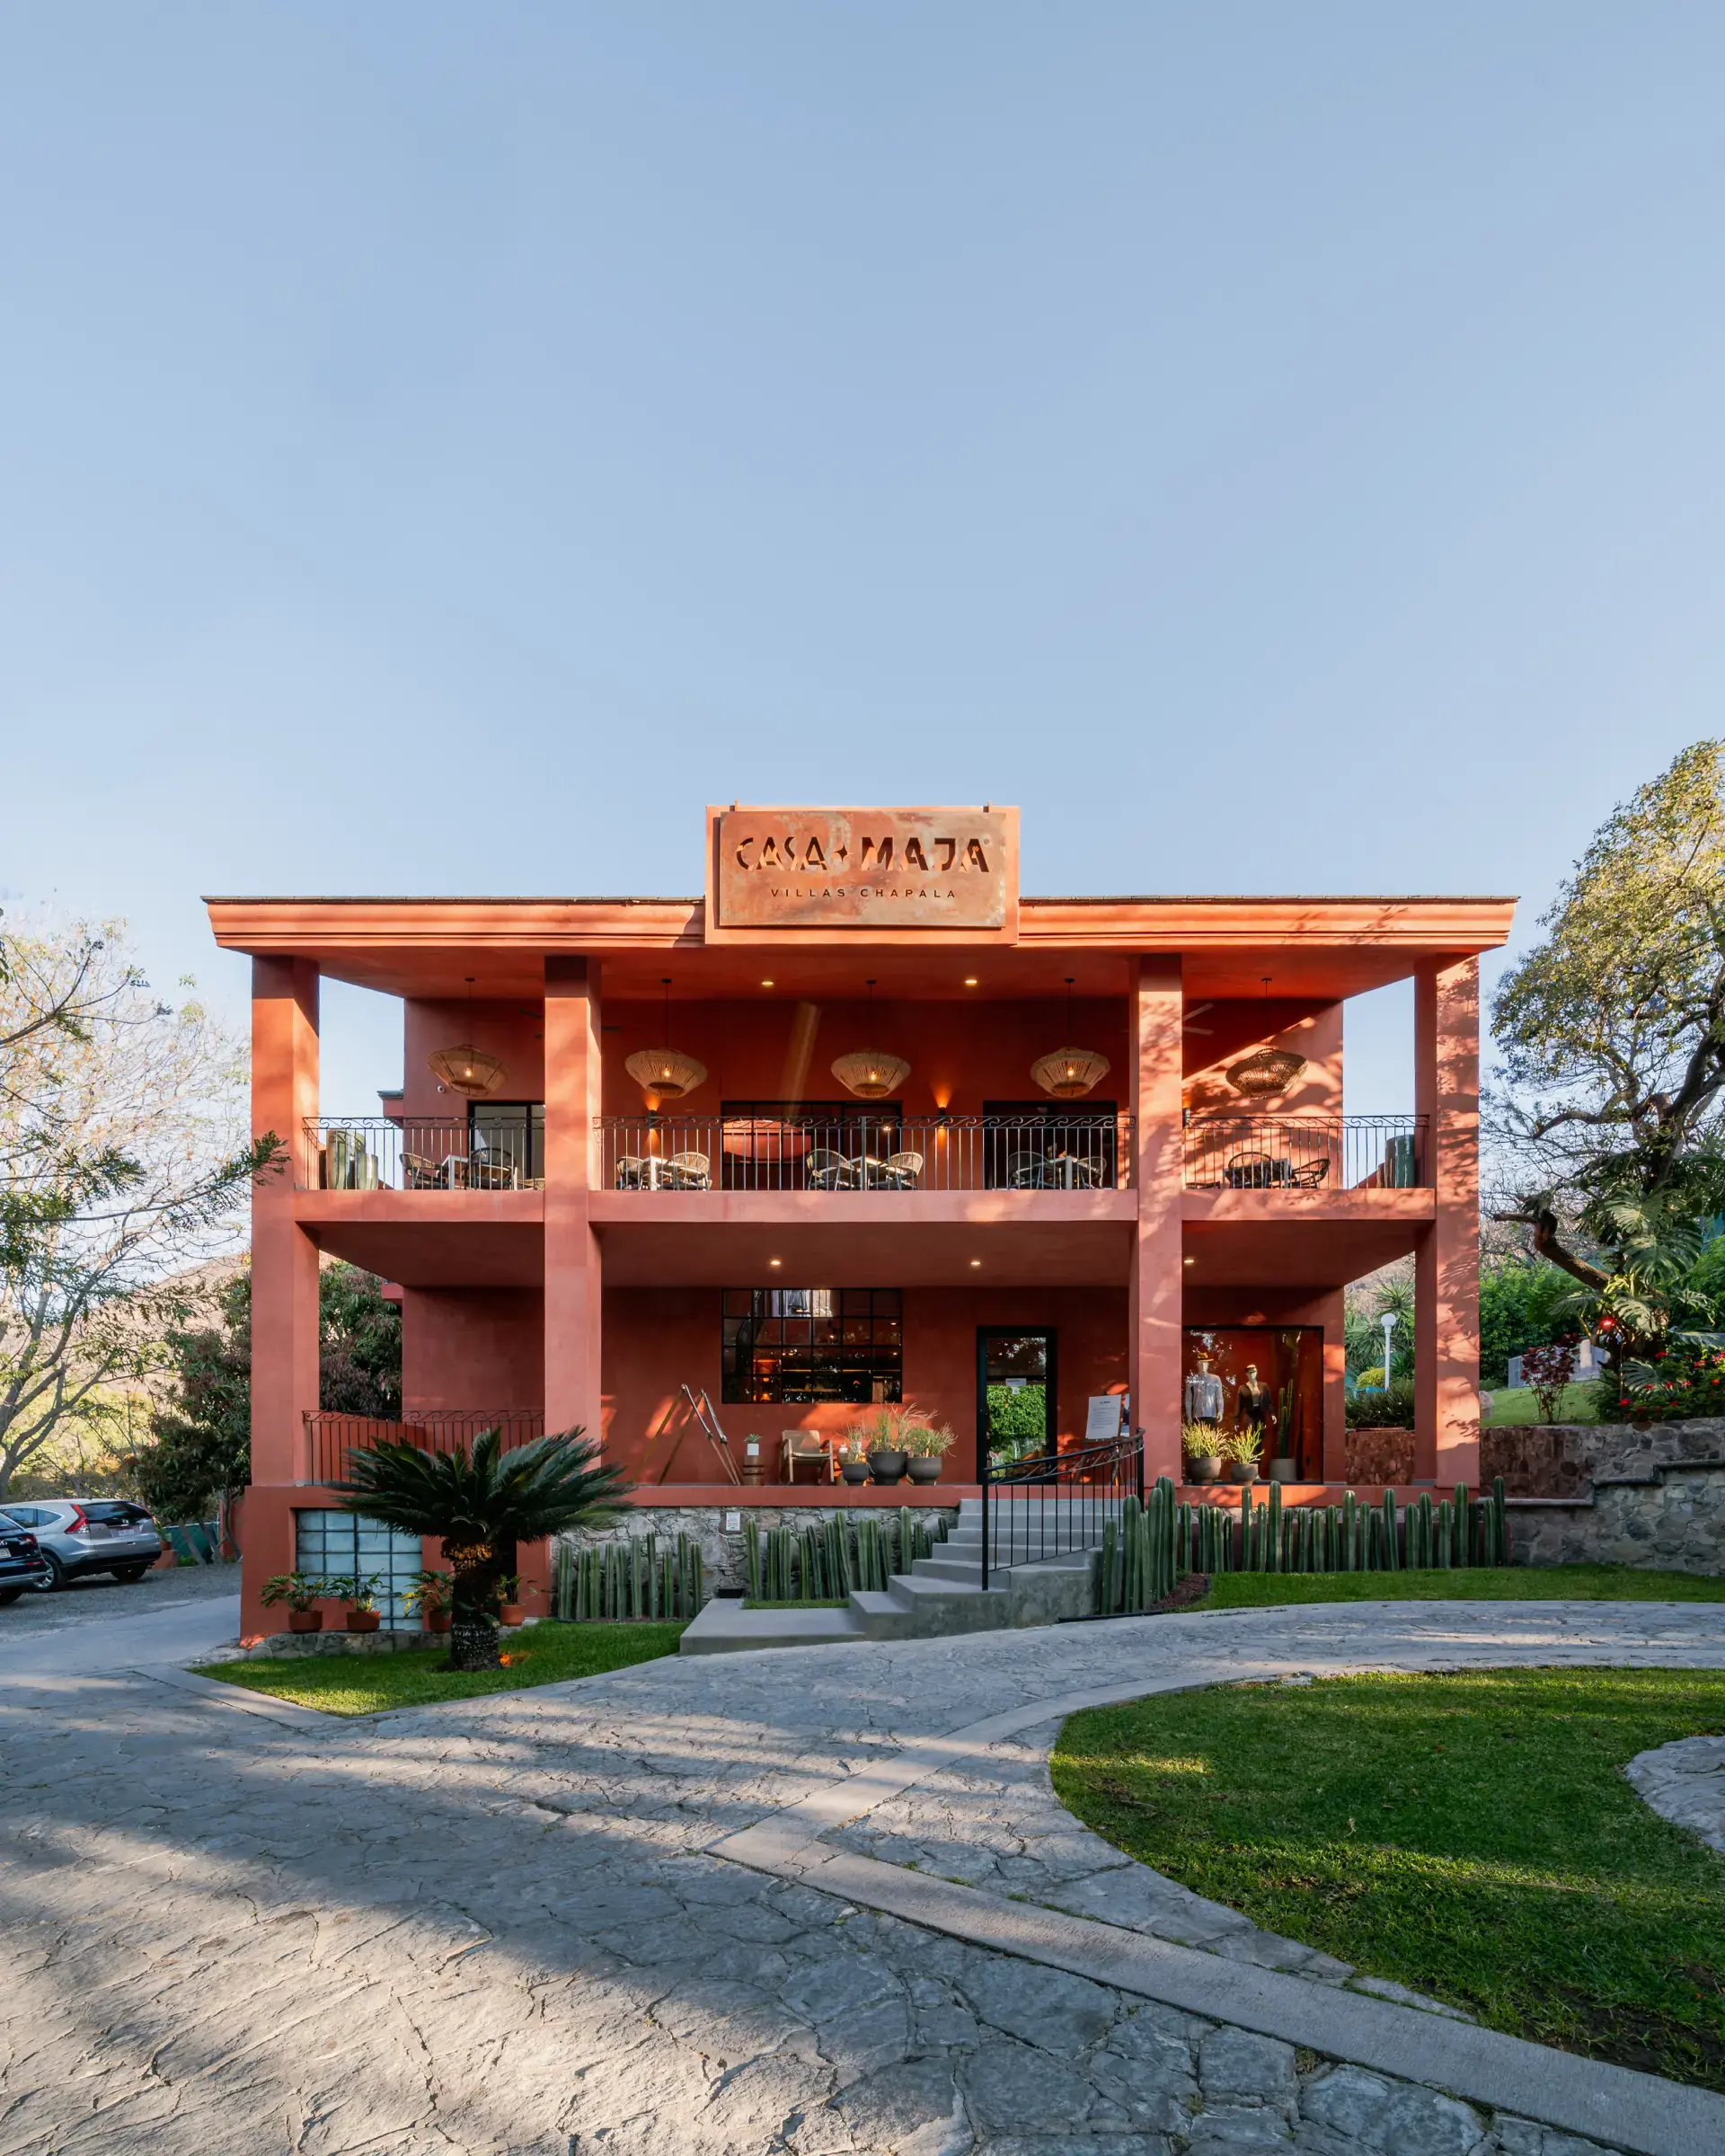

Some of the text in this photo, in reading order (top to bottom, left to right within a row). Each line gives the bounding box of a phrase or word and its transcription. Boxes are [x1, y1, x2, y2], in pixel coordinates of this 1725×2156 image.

[736, 836, 990, 873] CASA MAJA
[770, 888, 955, 898] VILLAS CHAPALA
